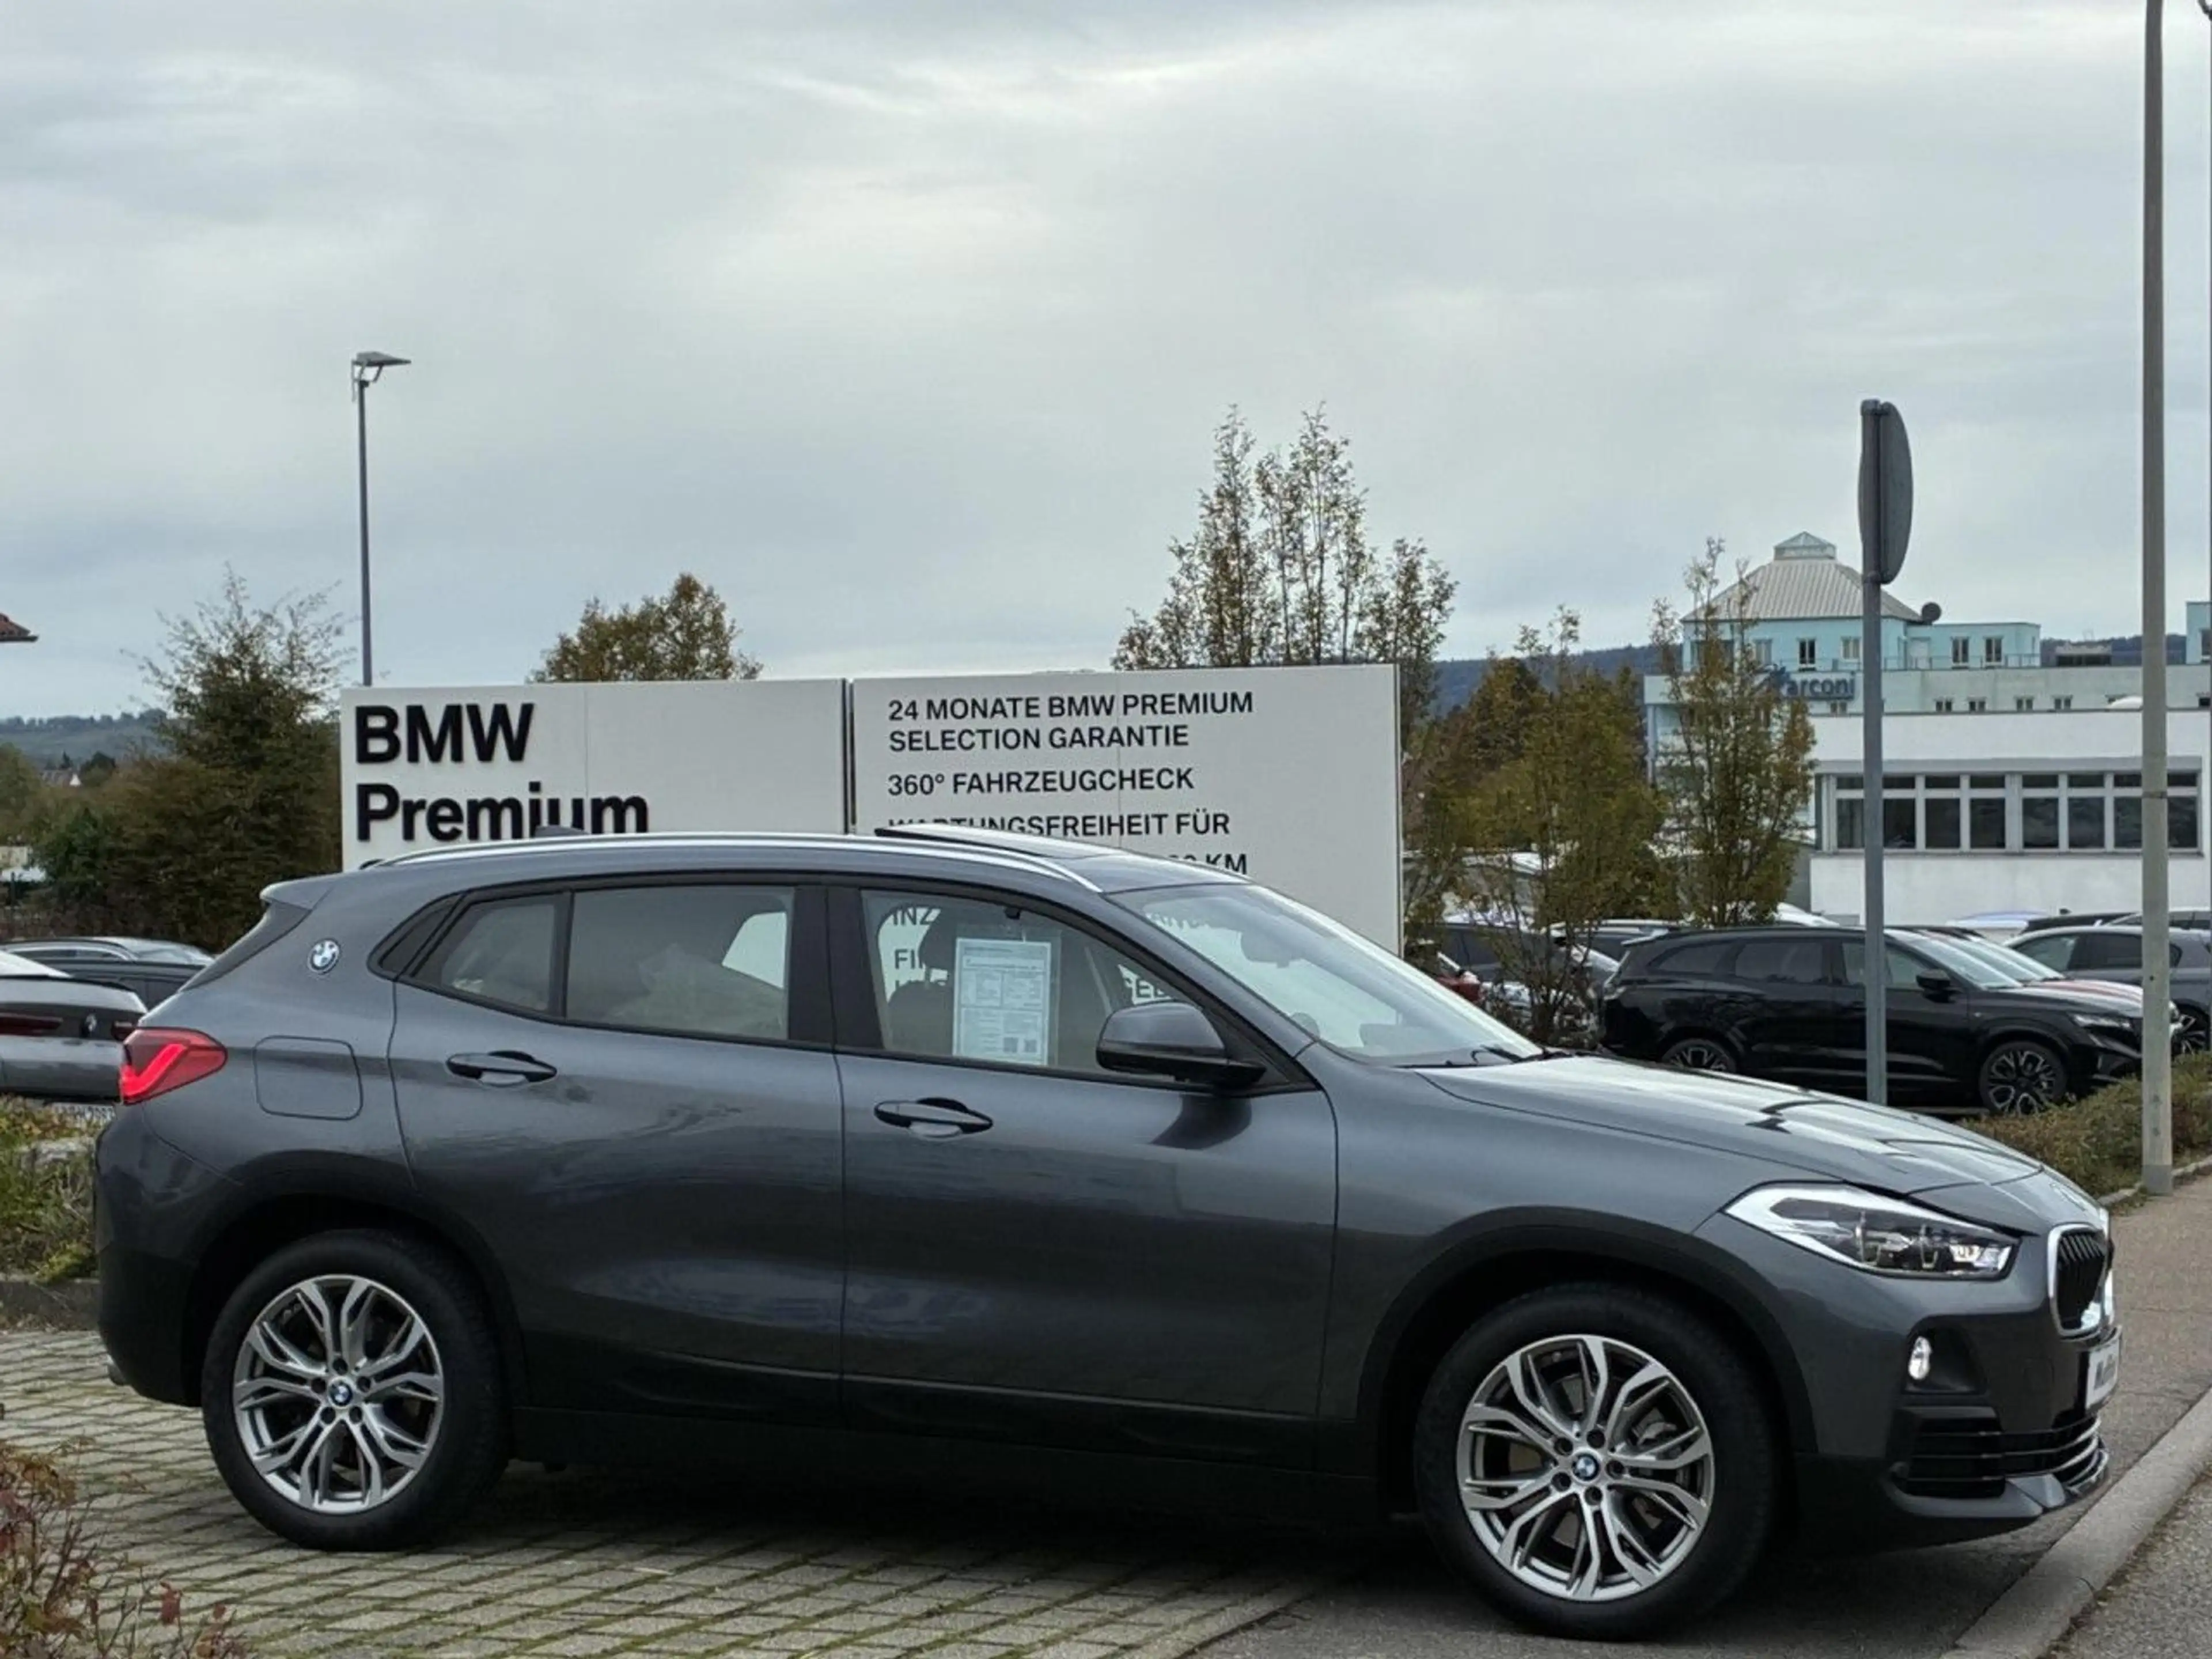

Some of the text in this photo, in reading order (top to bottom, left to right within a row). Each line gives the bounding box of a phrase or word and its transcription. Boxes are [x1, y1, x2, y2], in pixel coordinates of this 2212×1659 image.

[1770, 671, 1855, 696] arconi
[889, 692, 1253, 721] 24 MONATE BMW PREMIUM
[355, 702, 535, 765] BMW
[889, 725, 1189, 752] SELECTION GARANTIE
[888, 768, 1195, 796] 360° FAHRZEUGCHECK
[356, 781, 649, 843] Premium
[1176, 808, 1230, 835] FÜR
[1206, 853, 1247, 874] KM
